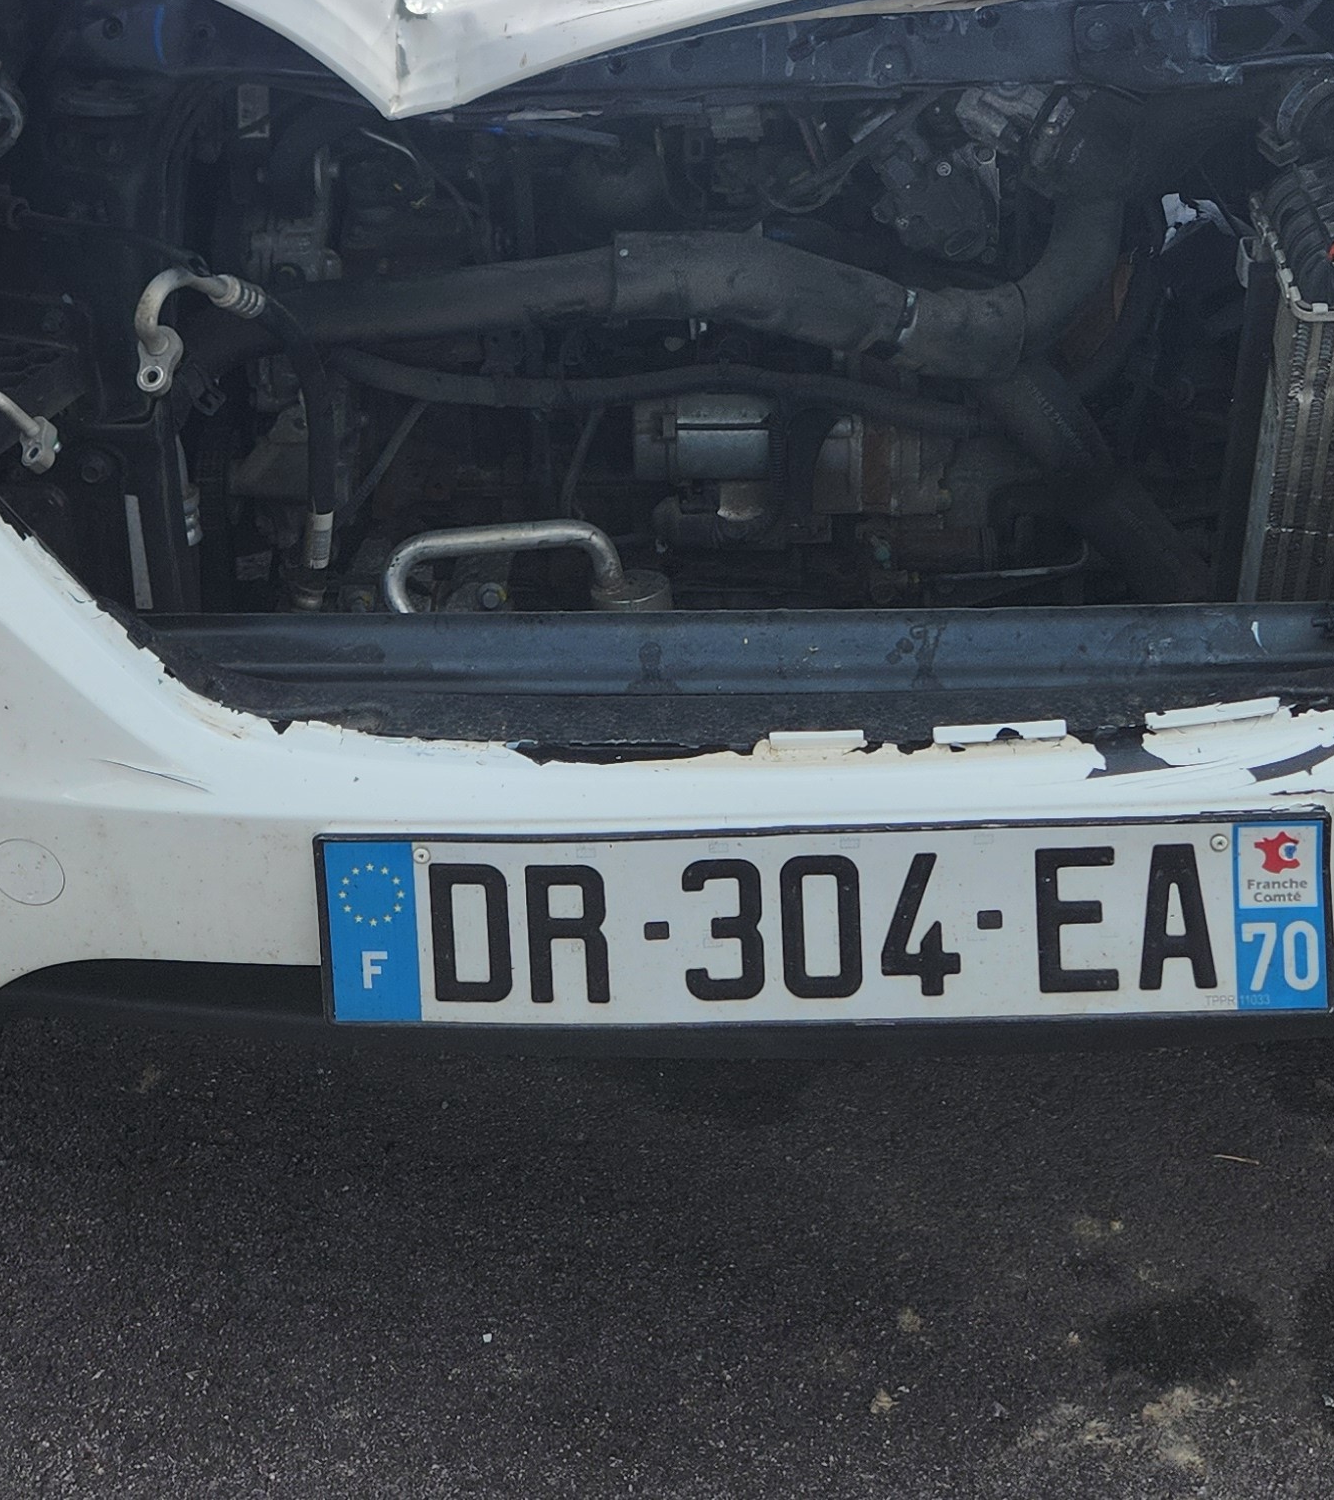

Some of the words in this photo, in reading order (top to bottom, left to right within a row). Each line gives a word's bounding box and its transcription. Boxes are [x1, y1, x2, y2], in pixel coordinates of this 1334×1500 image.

[1247, 878, 1308, 891] Franche
[1253, 891, 1302, 903] Comté
[1241, 920, 1320, 992] 70
[361, 950, 388, 989] F
